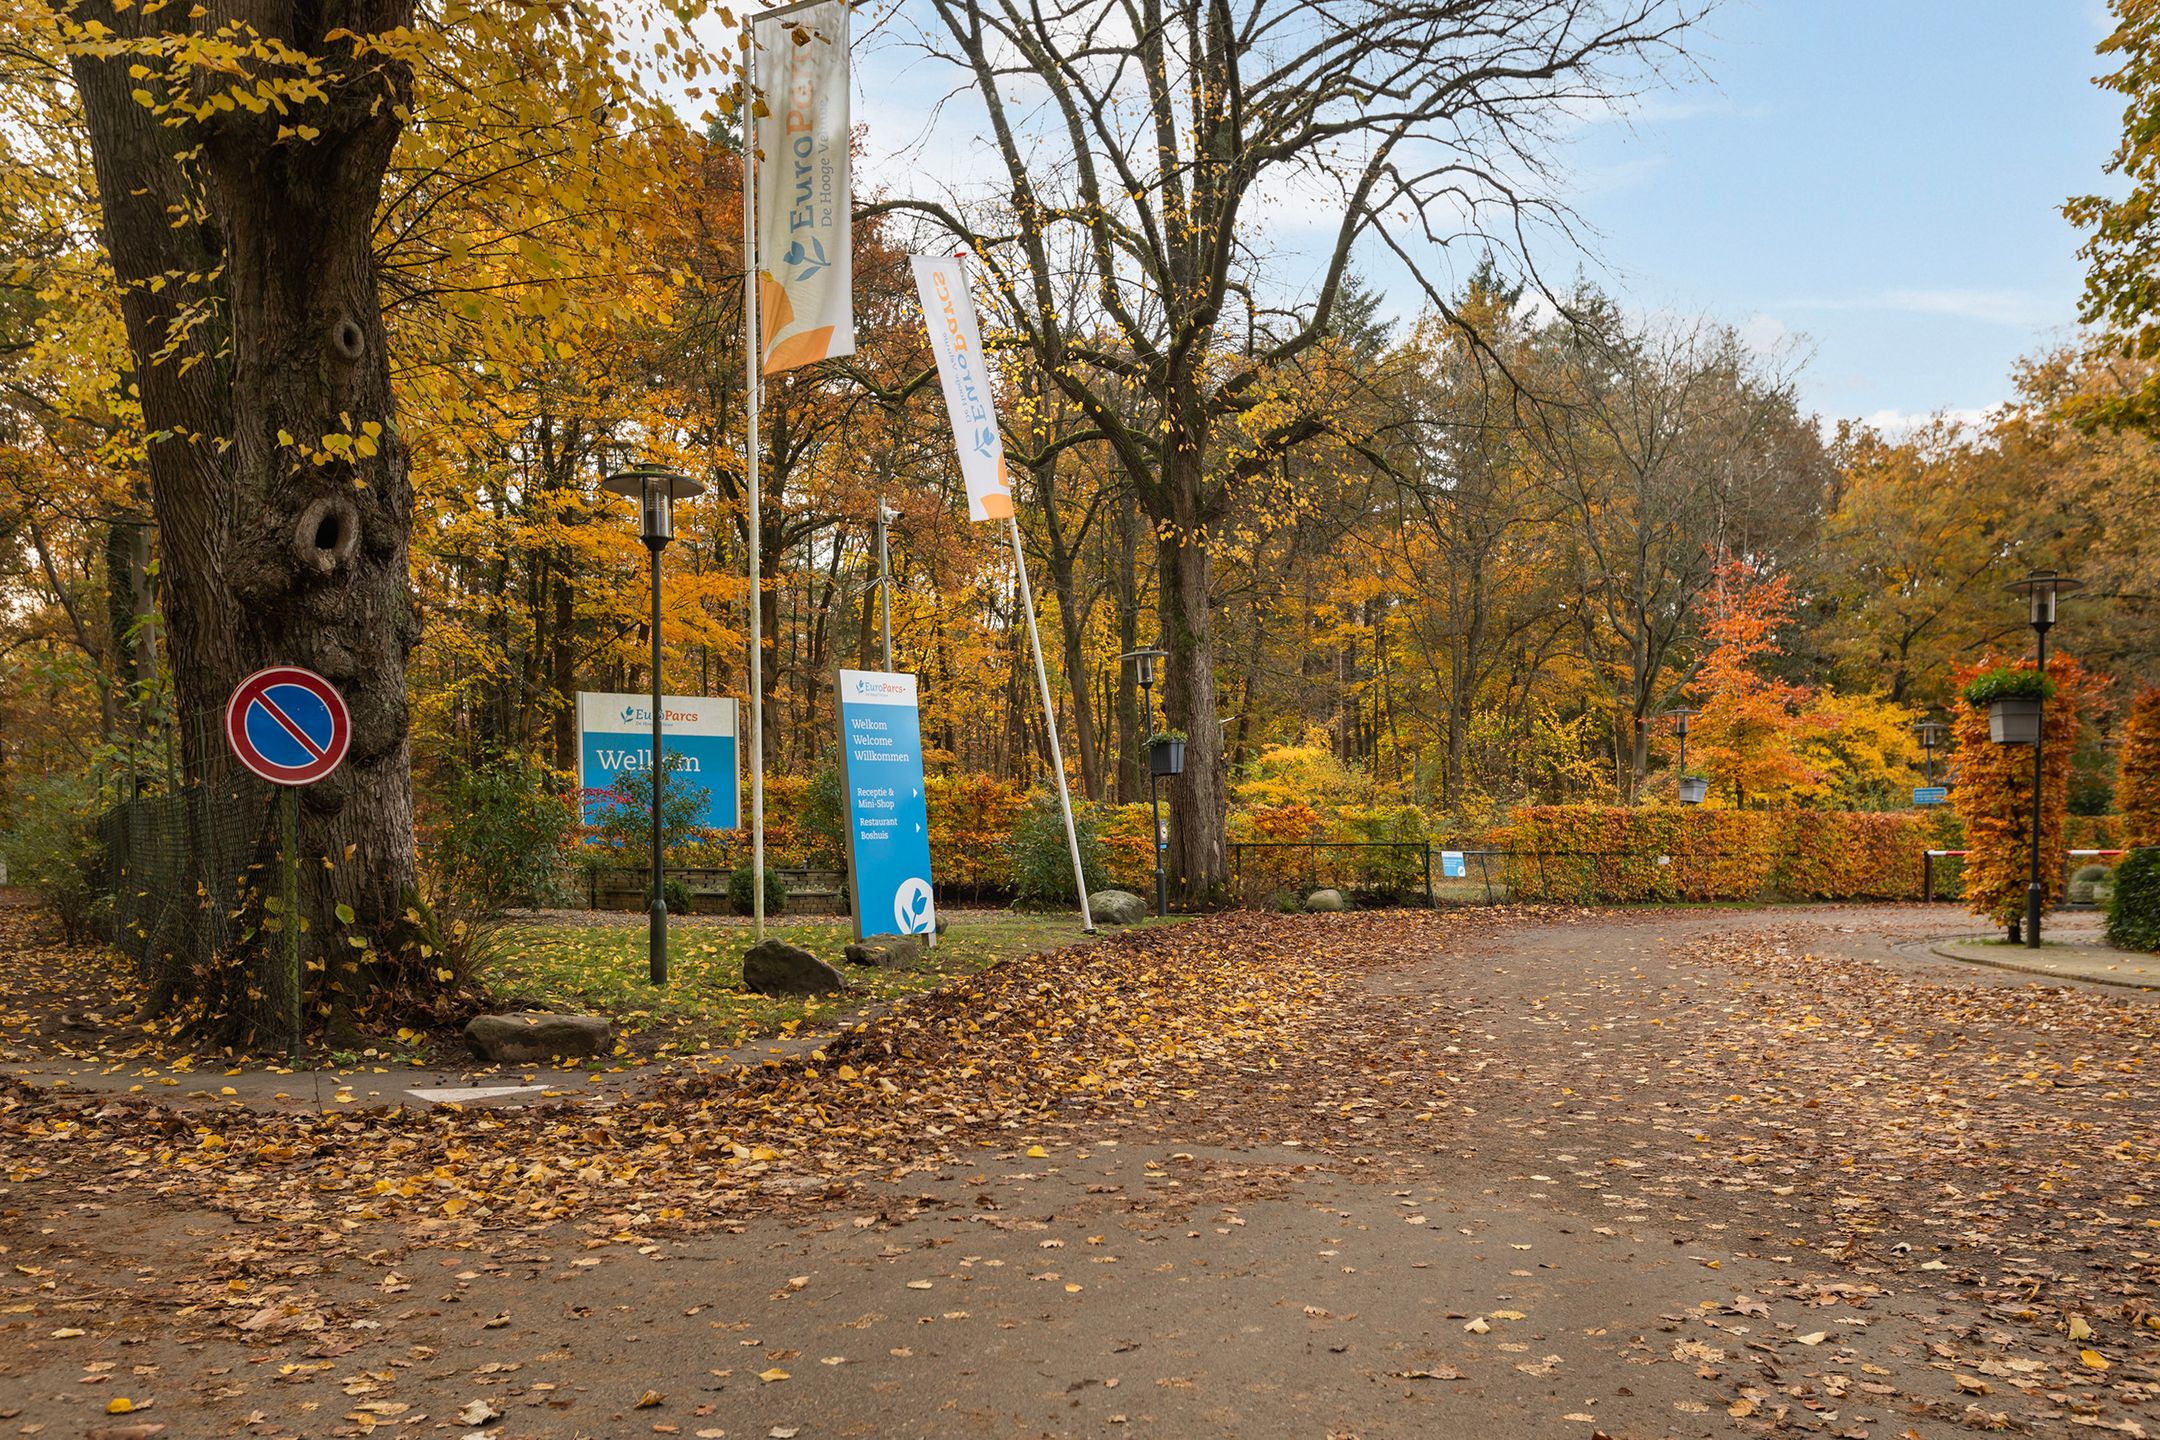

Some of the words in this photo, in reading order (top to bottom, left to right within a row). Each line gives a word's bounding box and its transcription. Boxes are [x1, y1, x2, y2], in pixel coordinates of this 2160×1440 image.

[785, 22, 815, 234] EuroParc
[820, 157, 834, 204] Hooge
[821, 206, 833, 228] De
[635, 708, 699, 722] EuoParcs
[850, 718, 888, 731] Welkom
[852, 734, 893, 746] Welcome
[853, 750, 910, 762] Willkommen
[857, 787, 888, 799] Receptie
[888, 788, 895, 797] &
[858, 799, 895, 811] Mini-Shop
[860, 817, 898, 827] Restaurant
[861, 830, 889, 840] Boshuis
